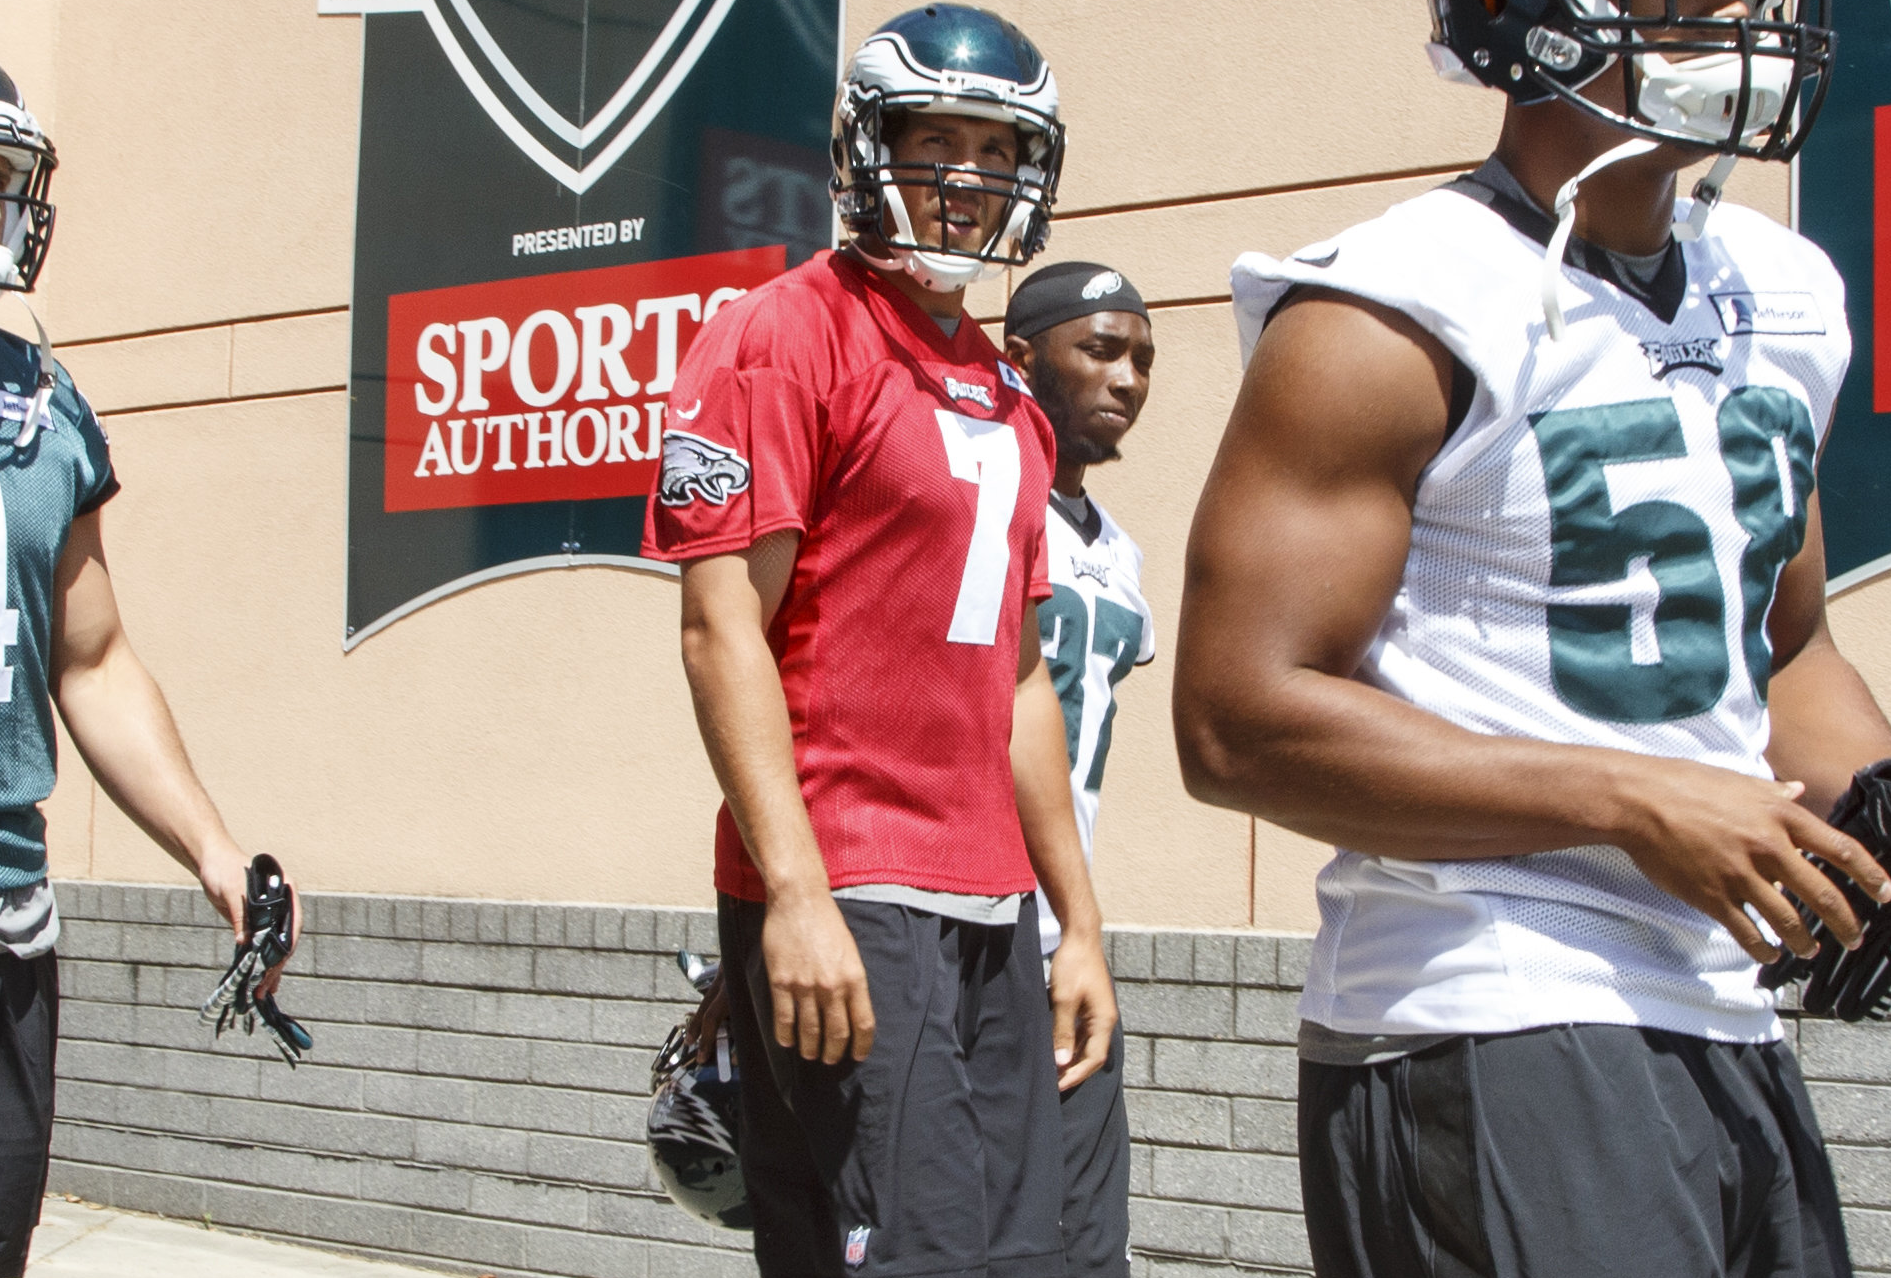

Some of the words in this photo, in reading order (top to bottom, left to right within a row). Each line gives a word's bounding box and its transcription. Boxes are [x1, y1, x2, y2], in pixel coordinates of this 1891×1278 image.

[512, 221, 617, 257] PRESENTED
[619, 217, 646, 243] BY
[413, 287, 748, 417] SPORT
[1639, 339, 1724, 380] EAGLES
[413, 401, 669, 478] AUTHORI
[934, 409, 1021, 646] 7
[1527, 384, 1817, 725] 58
